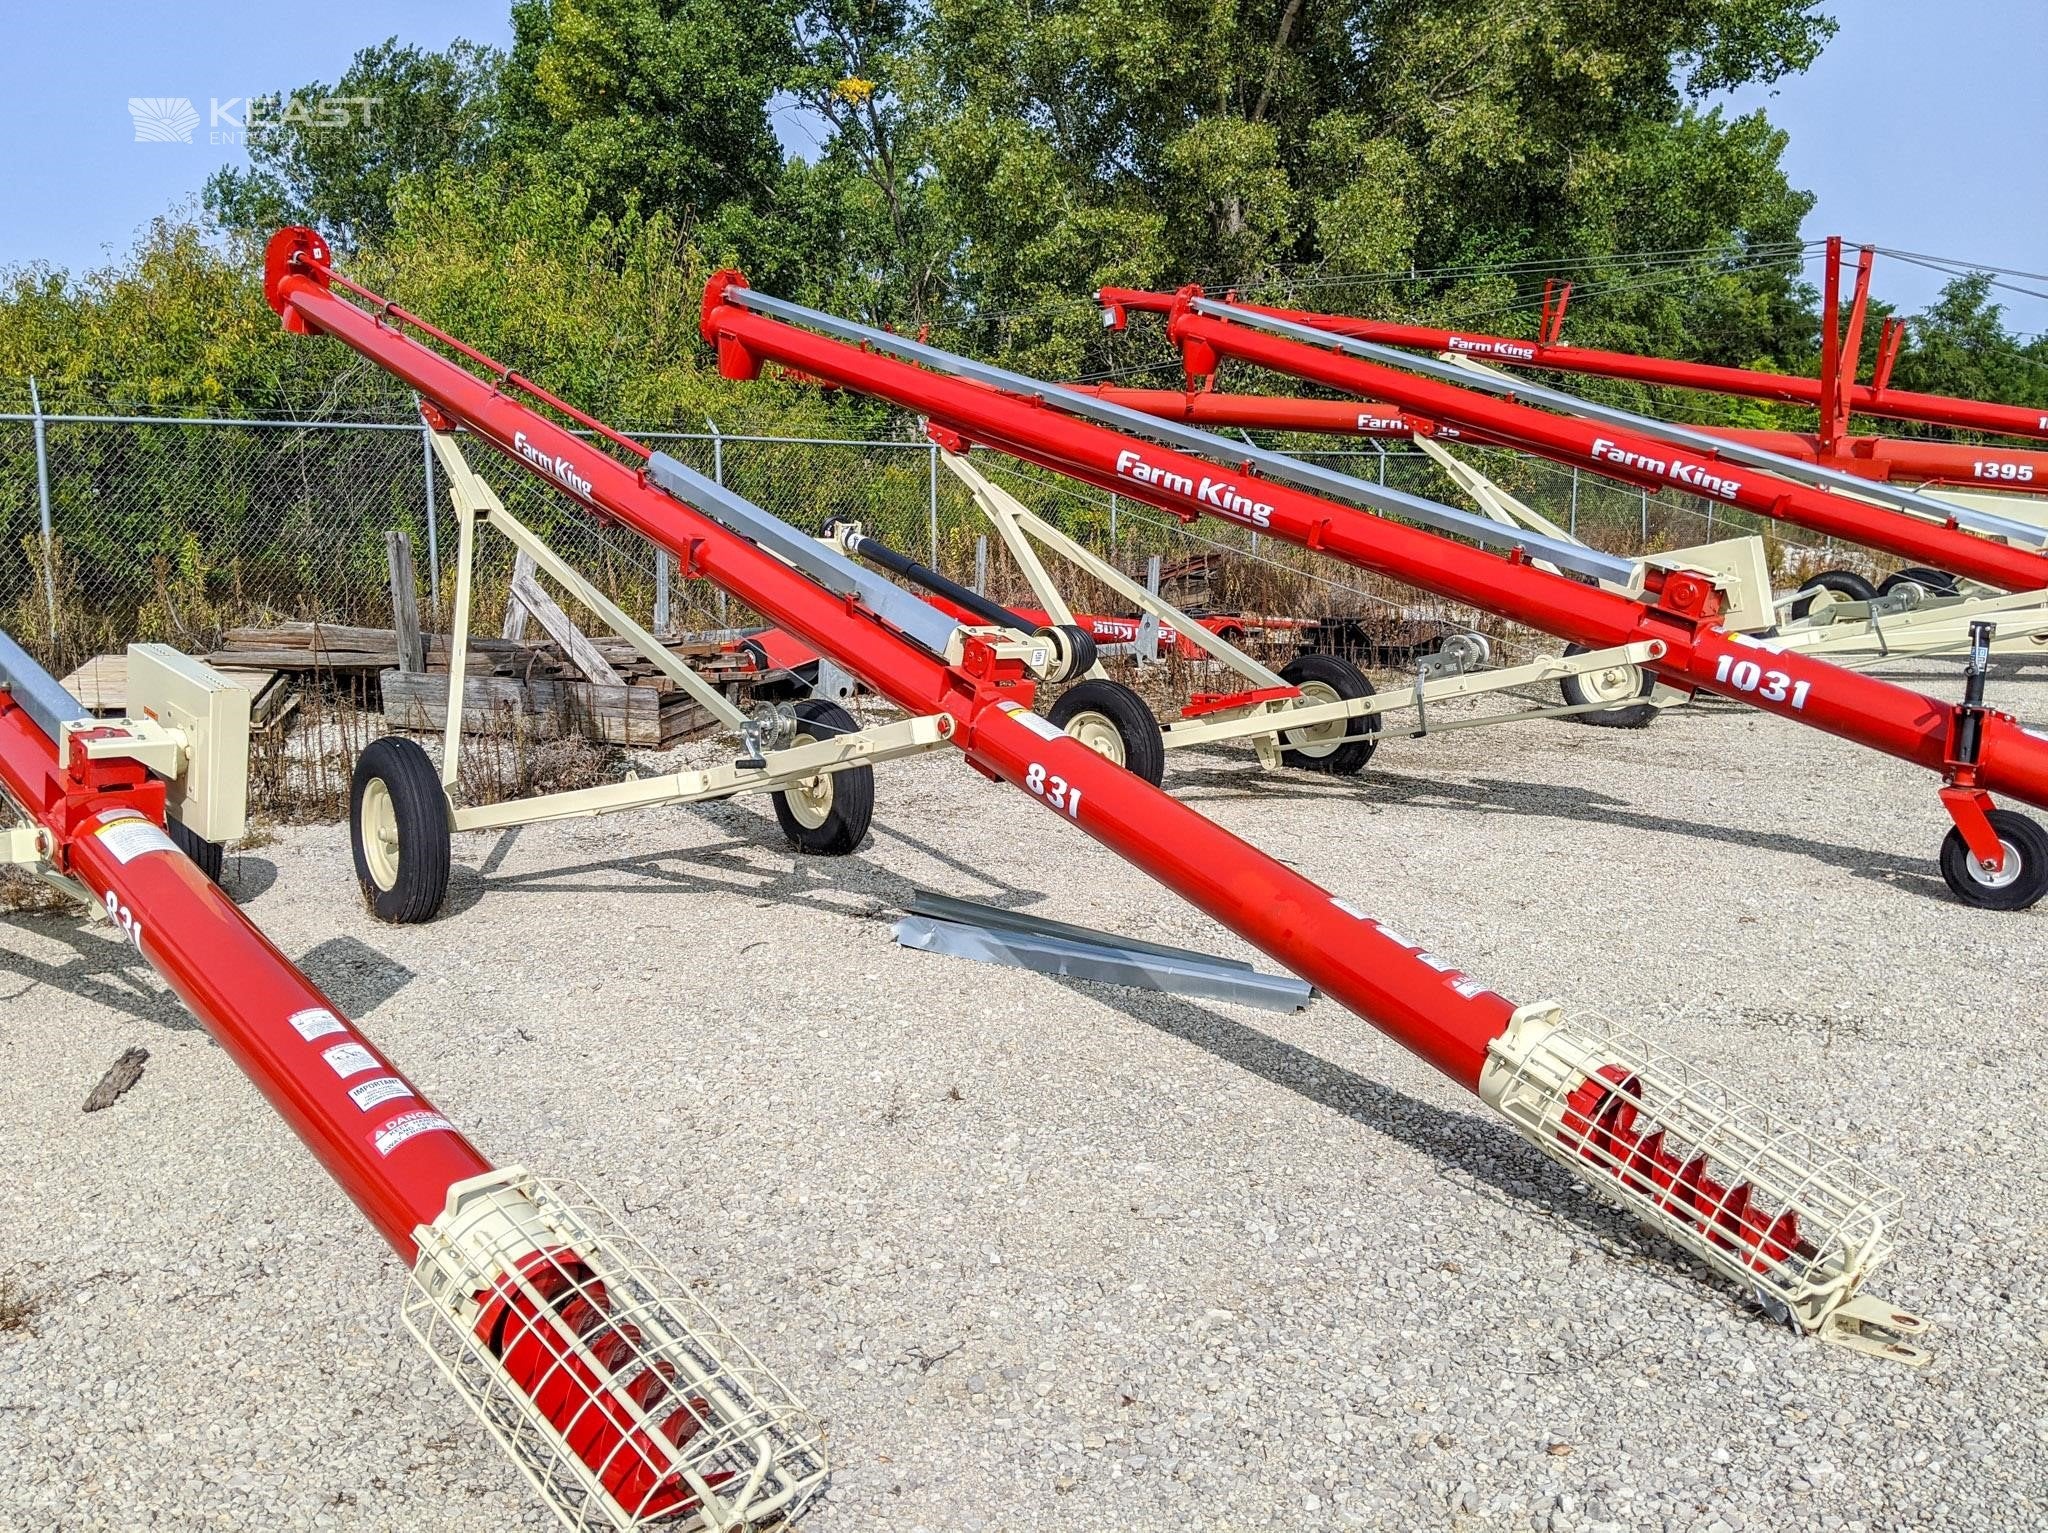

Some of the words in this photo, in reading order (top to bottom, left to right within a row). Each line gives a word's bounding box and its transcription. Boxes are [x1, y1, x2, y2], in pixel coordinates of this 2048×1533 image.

[1449, 336, 1492, 352] Farm
[1494, 342, 1535, 360] King
[514, 431, 553, 473] Farm
[555, 456, 593, 500] King
[1115, 450, 1194, 496] Farm
[1198, 477, 1275, 528] King
[1591, 438, 1666, 475] Farm
[1669, 460, 1742, 500] King
[1974, 461, 2034, 481] 1395
[1093, 620, 1133, 640] King
[1715, 654, 1811, 709] 1031
[1025, 762, 1082, 819] 831
[106, 890, 142, 951] 831
